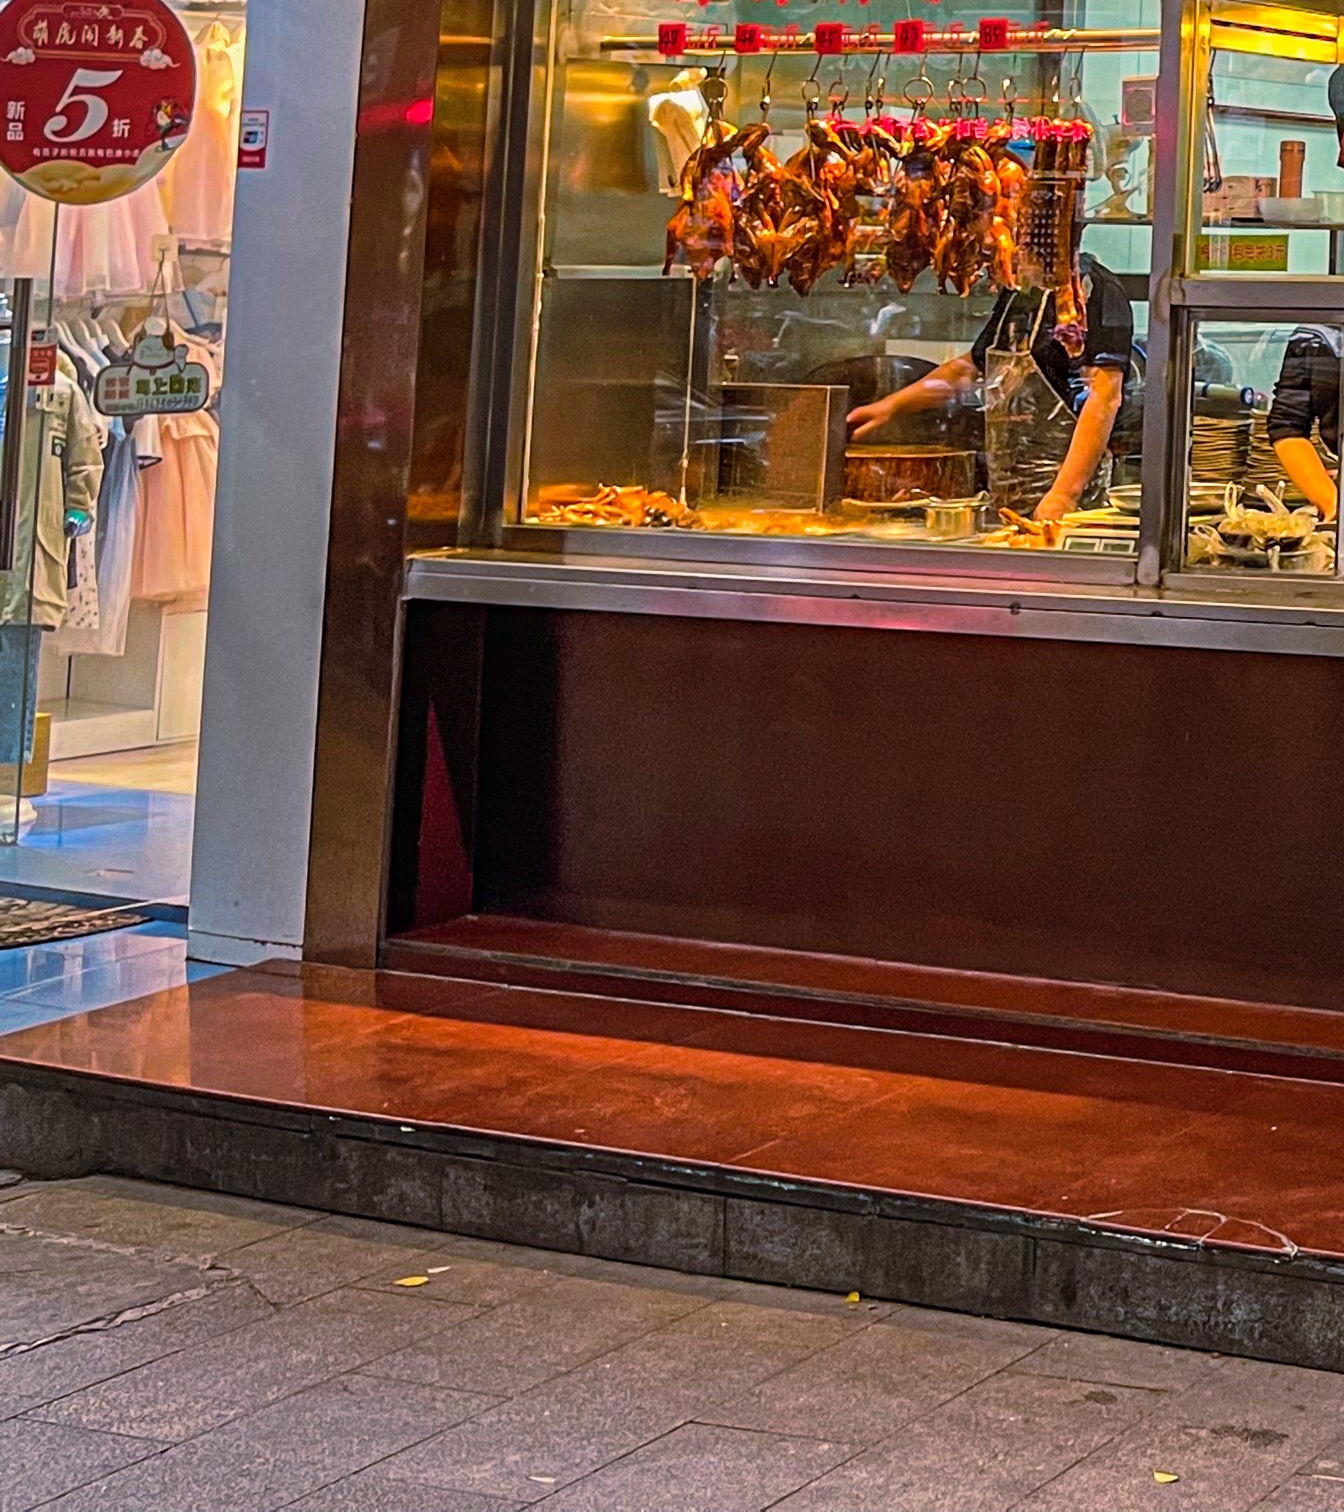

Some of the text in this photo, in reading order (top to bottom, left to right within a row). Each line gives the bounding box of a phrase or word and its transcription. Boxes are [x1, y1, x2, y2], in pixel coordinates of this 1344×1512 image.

[7, 101, 25, 141] 新品
[44, 68, 131, 143] 5 折
